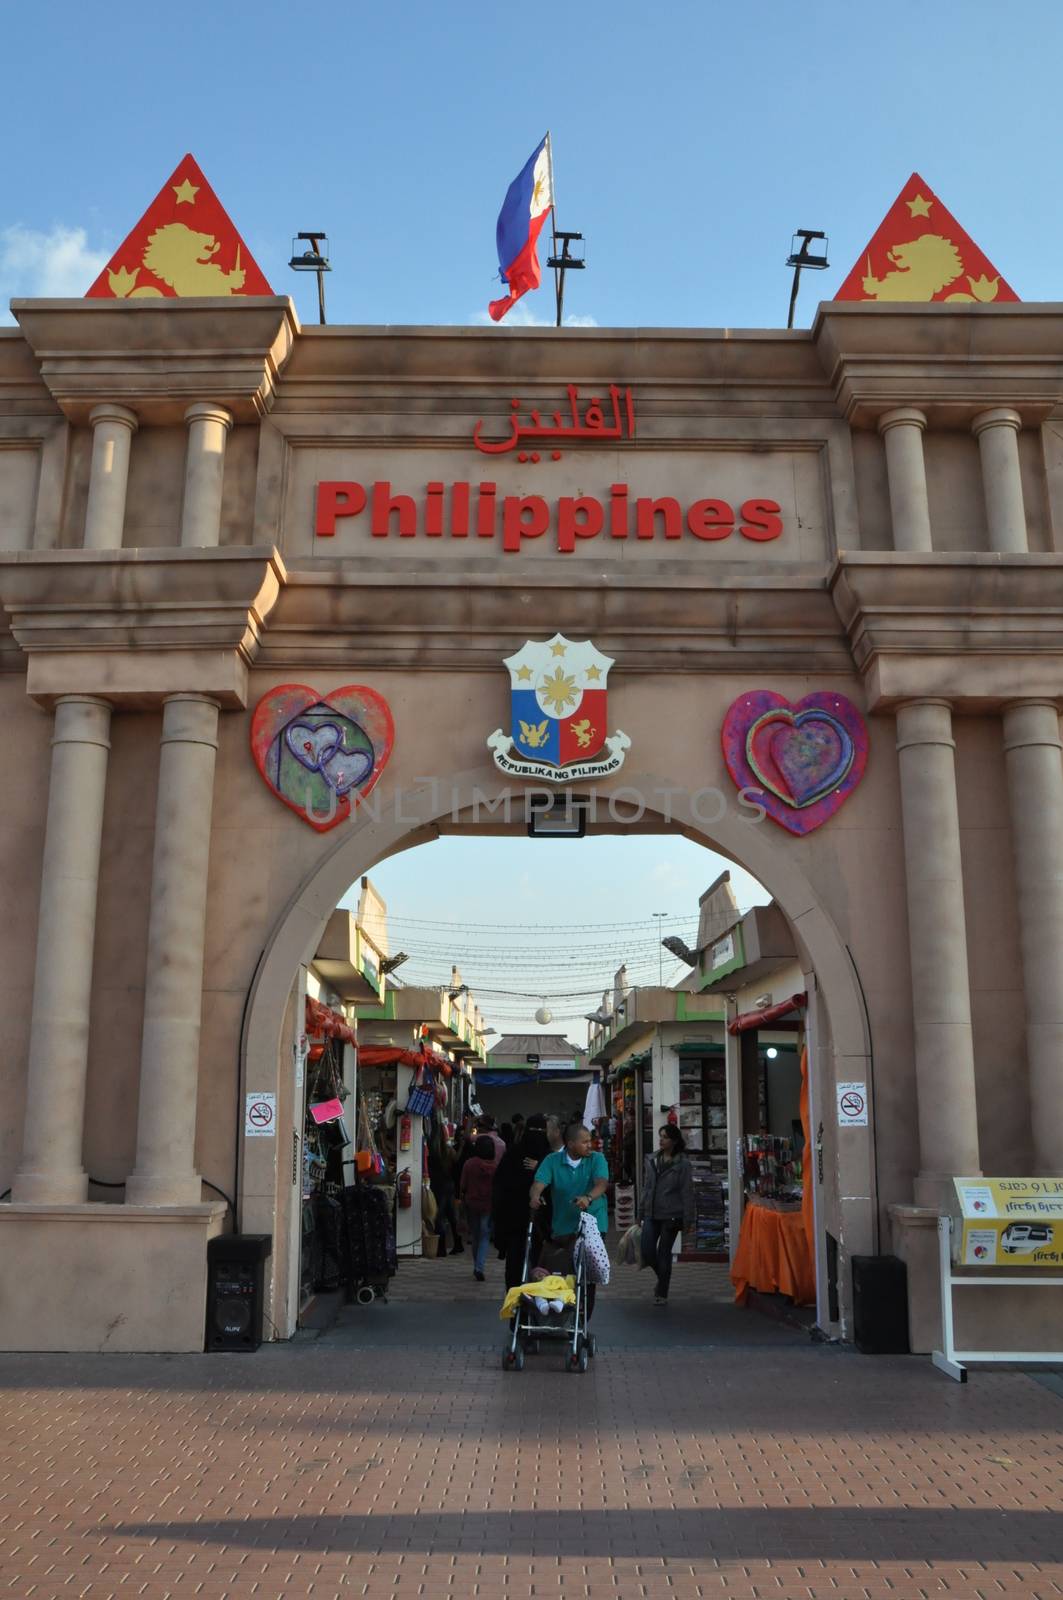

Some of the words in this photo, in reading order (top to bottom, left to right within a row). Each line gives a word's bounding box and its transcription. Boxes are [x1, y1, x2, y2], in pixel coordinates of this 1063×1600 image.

[473, 384, 635, 463] الفلبين
[316, 481, 784, 552] Philippines
[496, 754, 553, 778] REPUBLIKA
[554, 771, 569, 779] NG
[571, 758, 620, 777] PILIPINAS
[999, 1183, 1027, 1192] cars
[1031, 1183, 1050, 1193] 16
